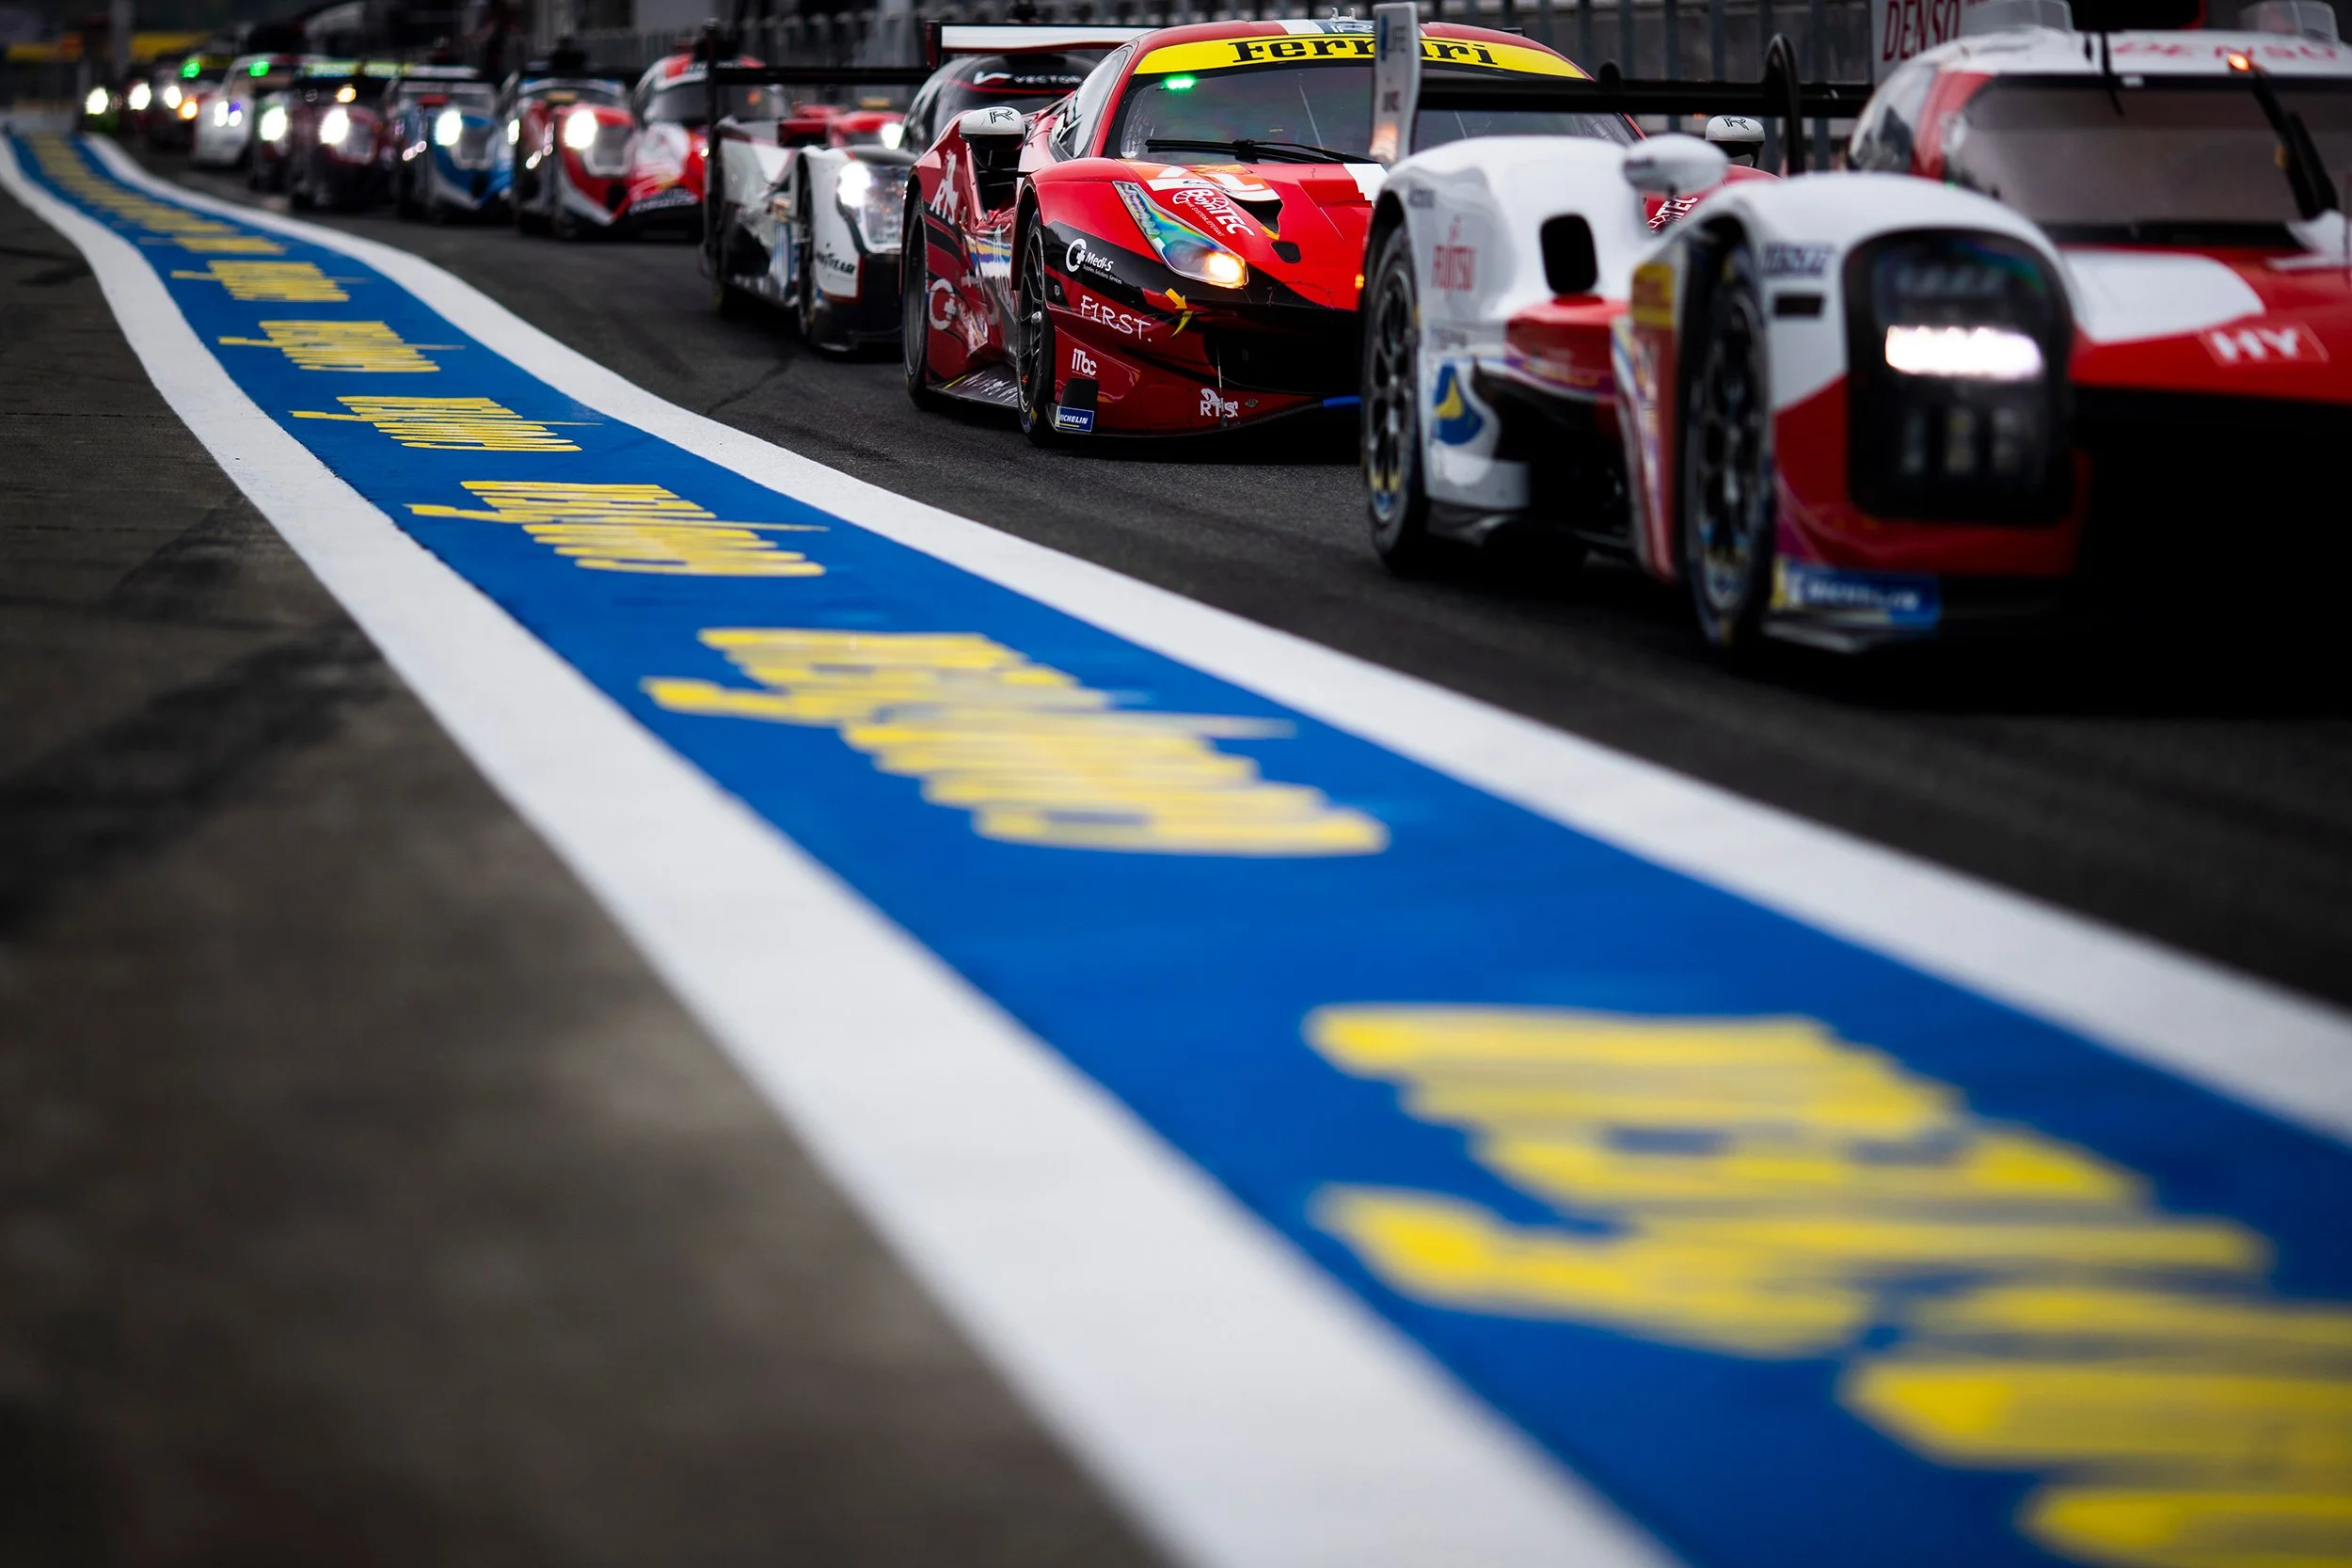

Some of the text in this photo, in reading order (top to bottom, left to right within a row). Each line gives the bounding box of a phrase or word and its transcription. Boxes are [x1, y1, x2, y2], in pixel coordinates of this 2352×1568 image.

[1883, 0, 1961, 61] DENSO
[1228, 39, 1498, 66] Ferrri
[1014, 75, 1082, 85] VECTOR
[1085, 251, 1115, 273] Medi-S
